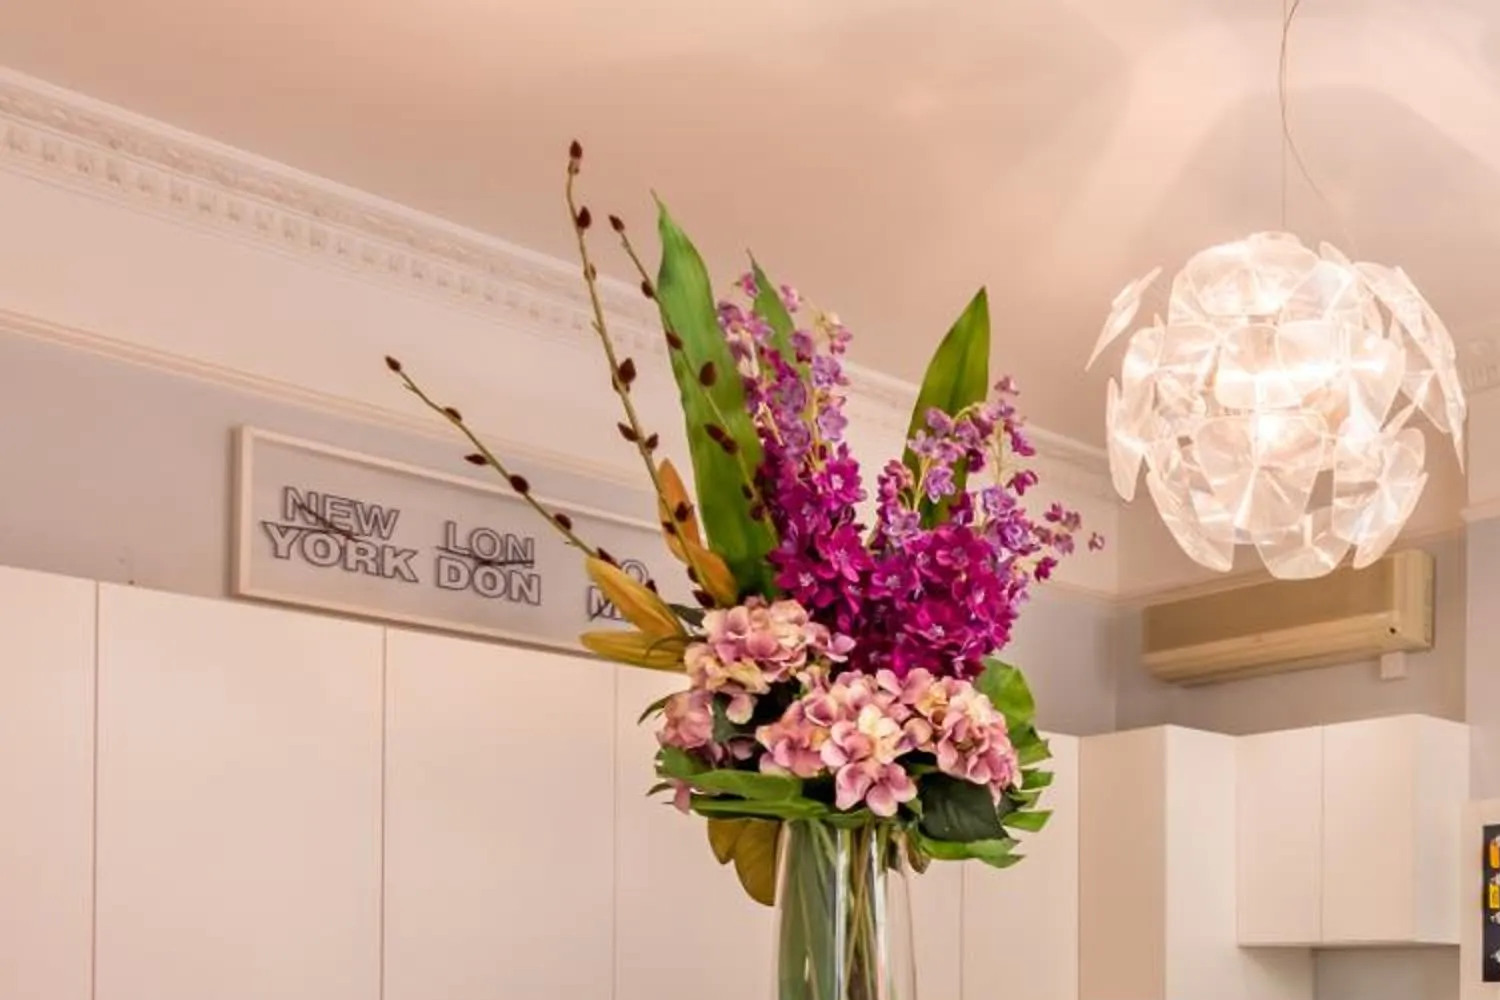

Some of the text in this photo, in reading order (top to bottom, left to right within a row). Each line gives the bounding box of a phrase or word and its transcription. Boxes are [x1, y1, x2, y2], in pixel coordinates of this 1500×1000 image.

[283, 486, 400, 541] NEW
[260, 521, 419, 583] YORK
[445, 520, 534, 569] LON
[436, 555, 541, 606] DON
